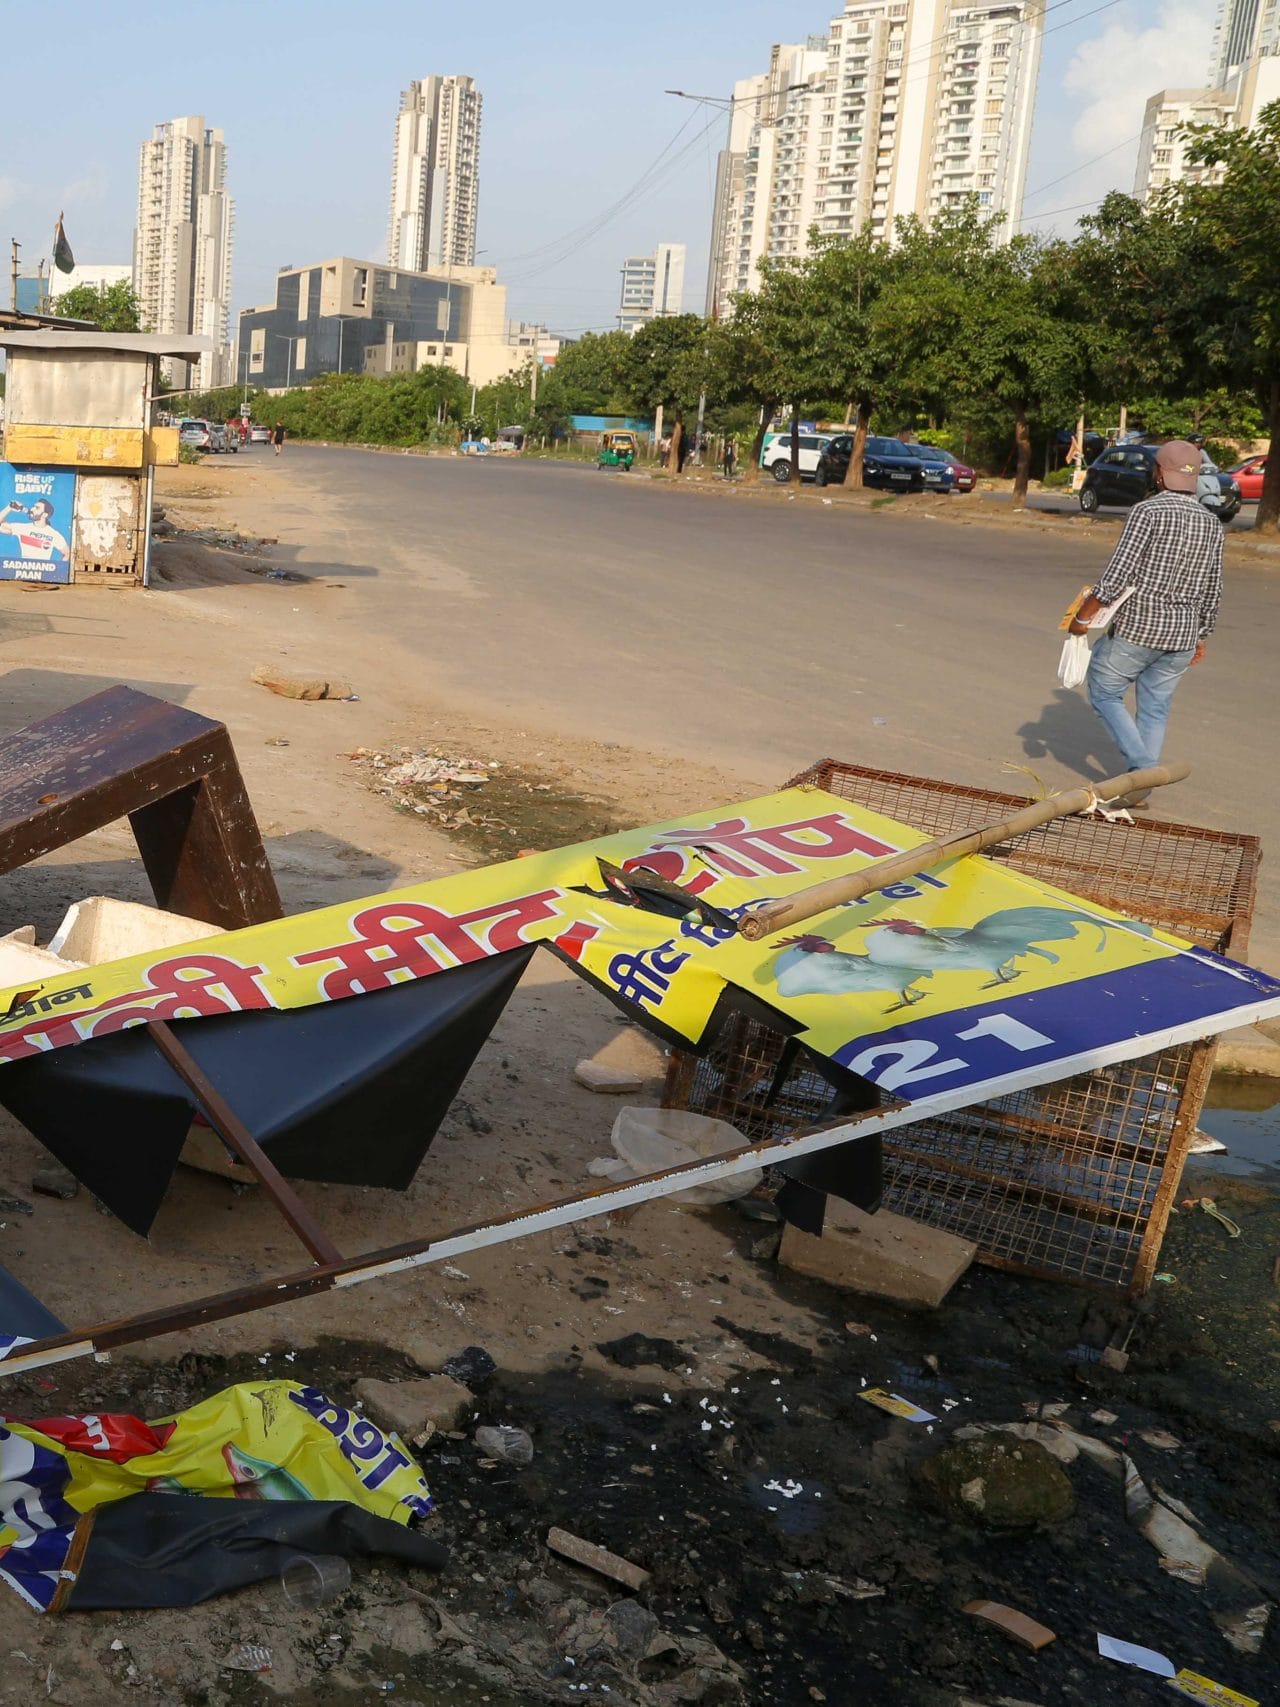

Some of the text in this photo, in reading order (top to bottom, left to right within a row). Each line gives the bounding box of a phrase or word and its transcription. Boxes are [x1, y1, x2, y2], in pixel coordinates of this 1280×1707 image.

[15, 483, 53, 496] BABY!
[2, 560, 56, 573] SADANAND
[15, 570, 43, 580] PAAN
